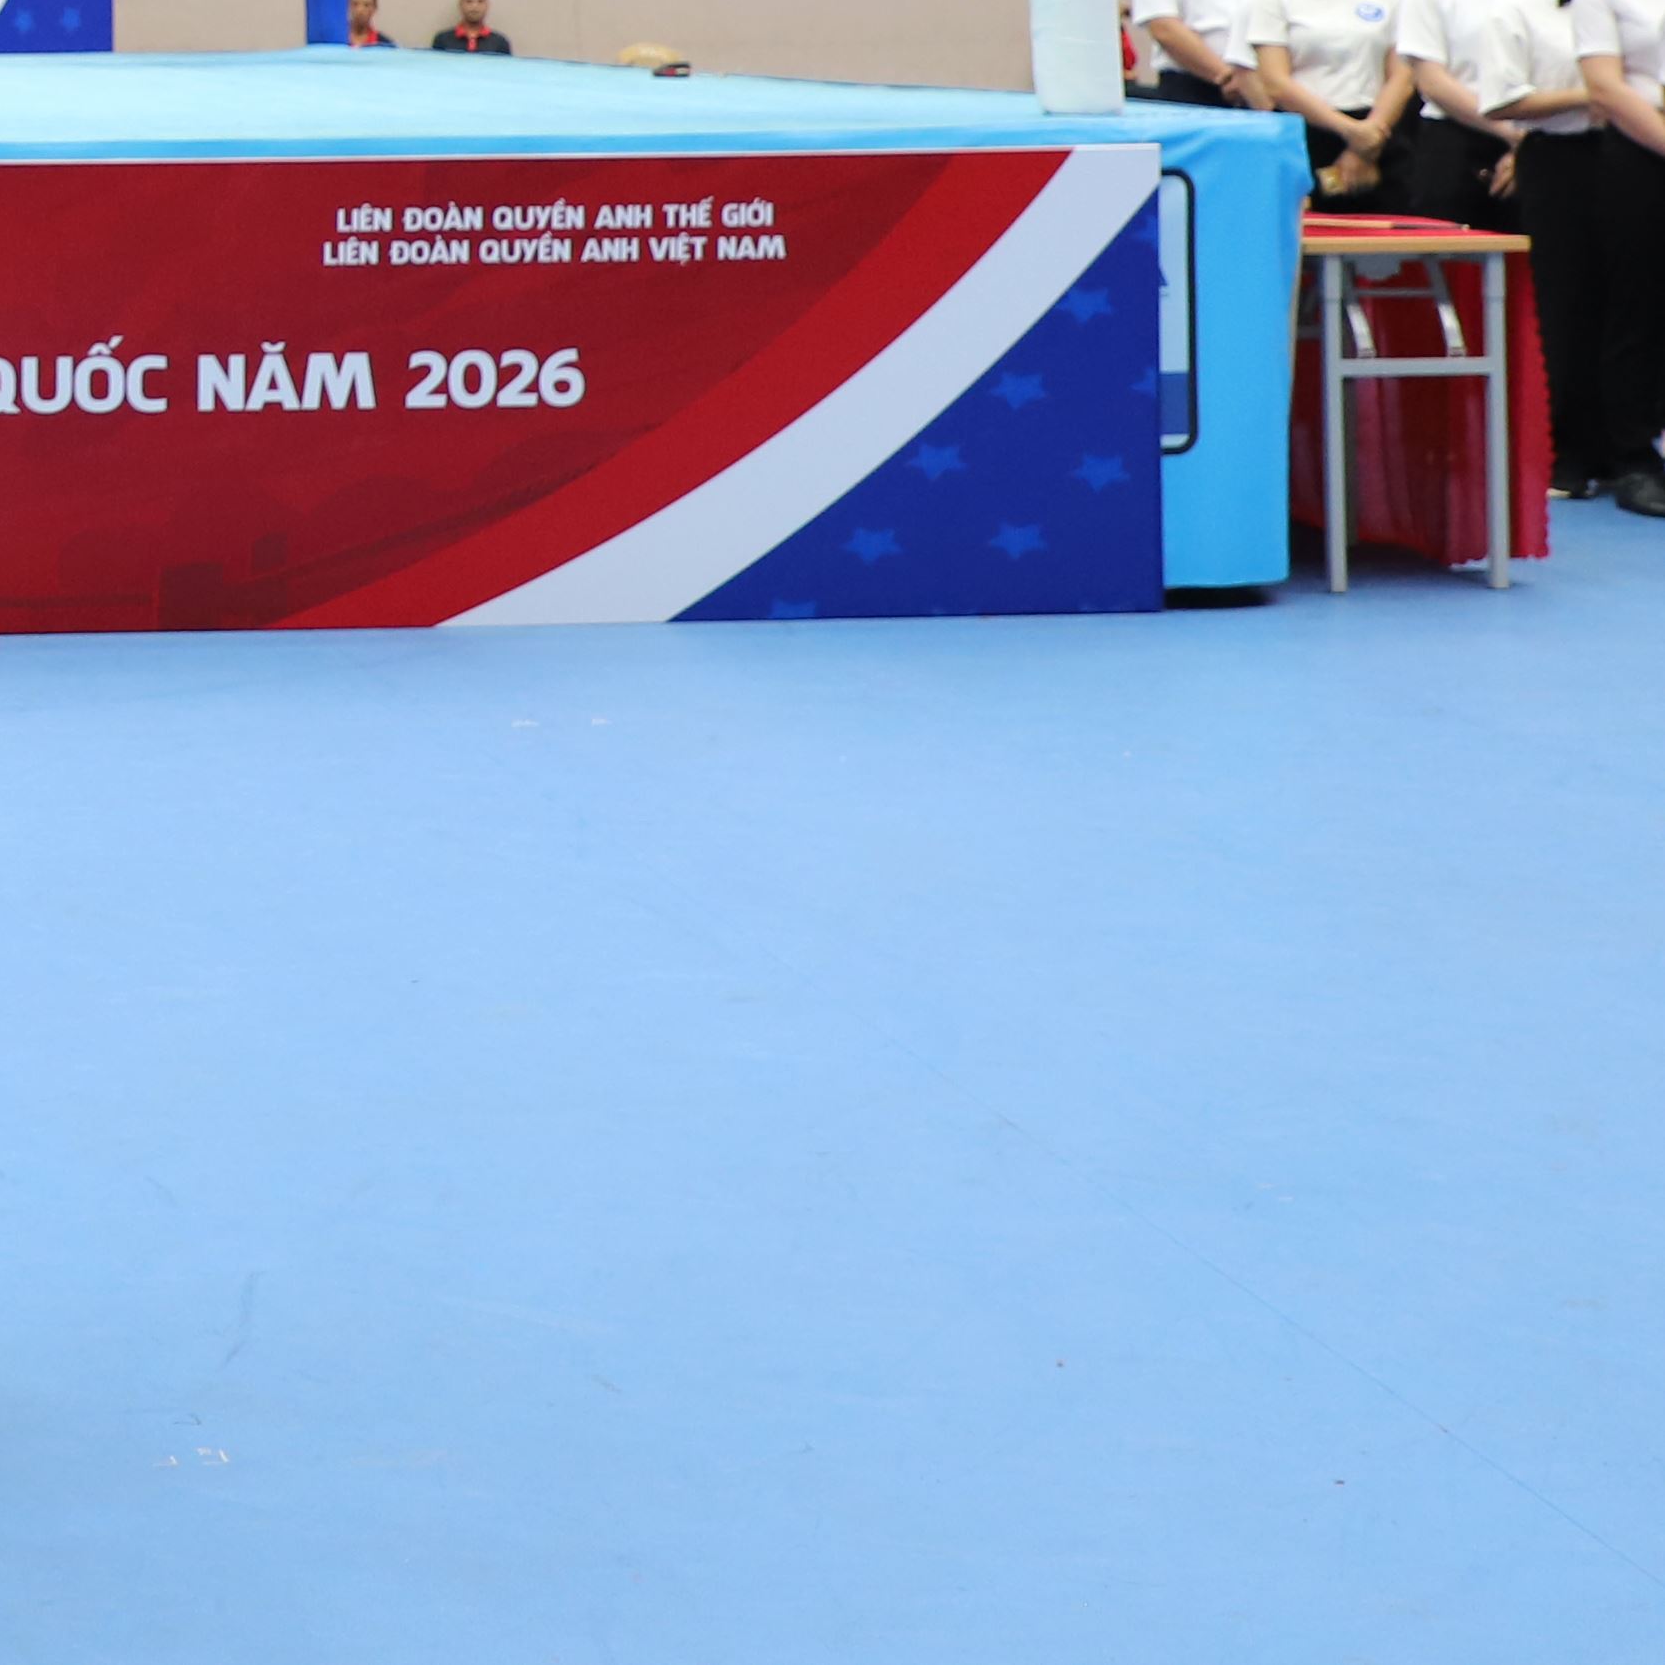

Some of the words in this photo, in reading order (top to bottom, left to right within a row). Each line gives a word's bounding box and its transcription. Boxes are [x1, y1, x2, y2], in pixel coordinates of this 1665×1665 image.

[337, 203, 392, 232] LIÊN
[402, 201, 482, 231] ĐOÀN
[492, 198, 584, 230] QUYỀN
[594, 205, 652, 229] ANH
[663, 196, 713, 228] THẾ
[722, 197, 773, 227] GIỚI
[323, 237, 378, 265] LIÊN
[389, 234, 469, 264] ĐOÀN
[479, 232, 571, 263] QUYỀN
[581, 238, 639, 262] ANH
[650, 233, 707, 265] VIỆT
[717, 235, 786, 260] NAM
[198, 341, 376, 412] NĂM
[405, 347, 585, 409] 2026
